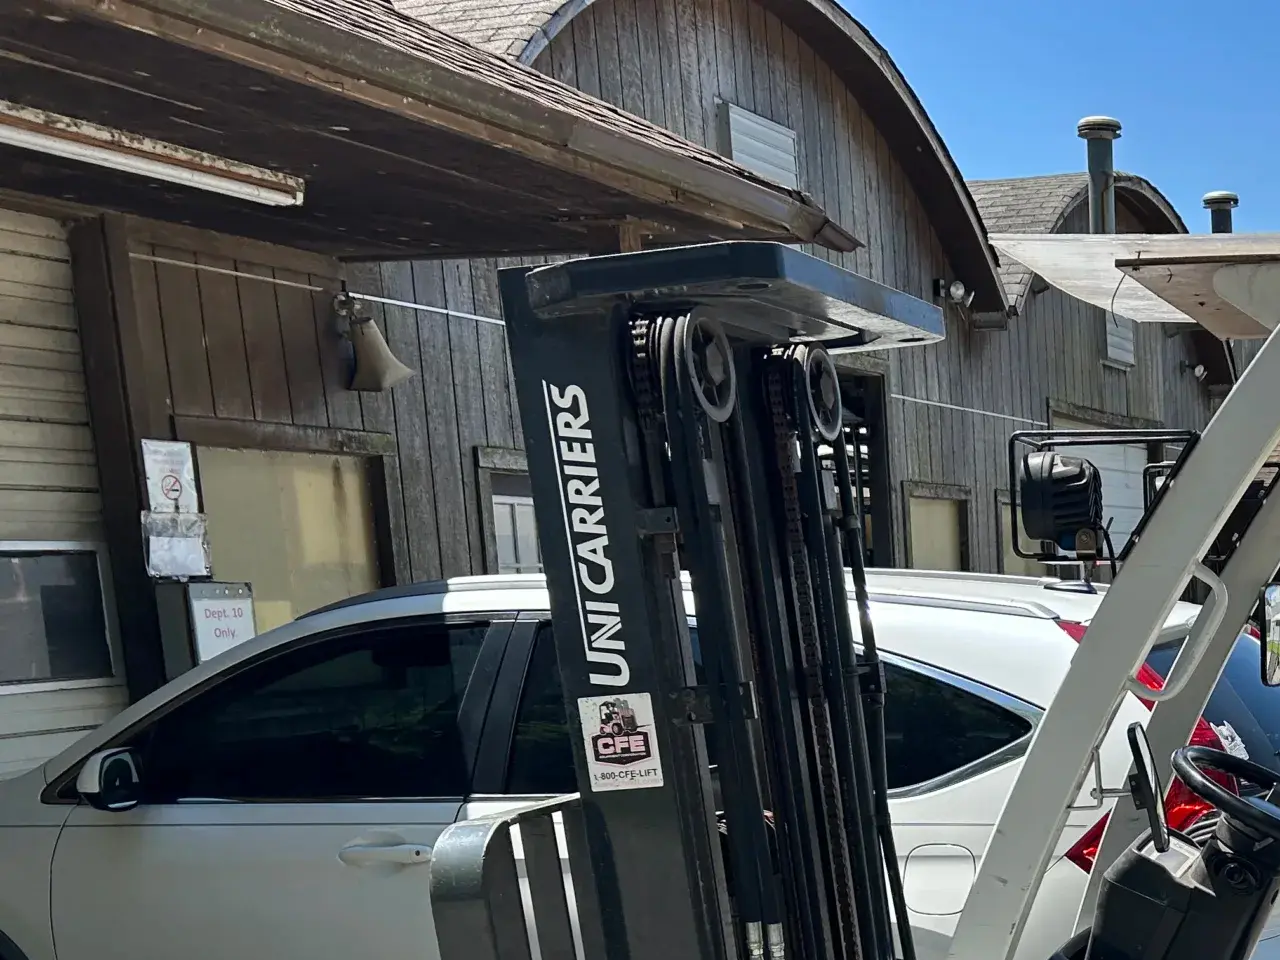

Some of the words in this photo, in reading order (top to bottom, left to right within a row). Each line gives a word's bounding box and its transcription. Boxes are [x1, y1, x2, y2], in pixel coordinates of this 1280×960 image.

[204, 608, 230, 621] Dept.
[597, 735, 646, 755] CFE
[593, 768, 658, 782] 1-800-CFE-LIFT
